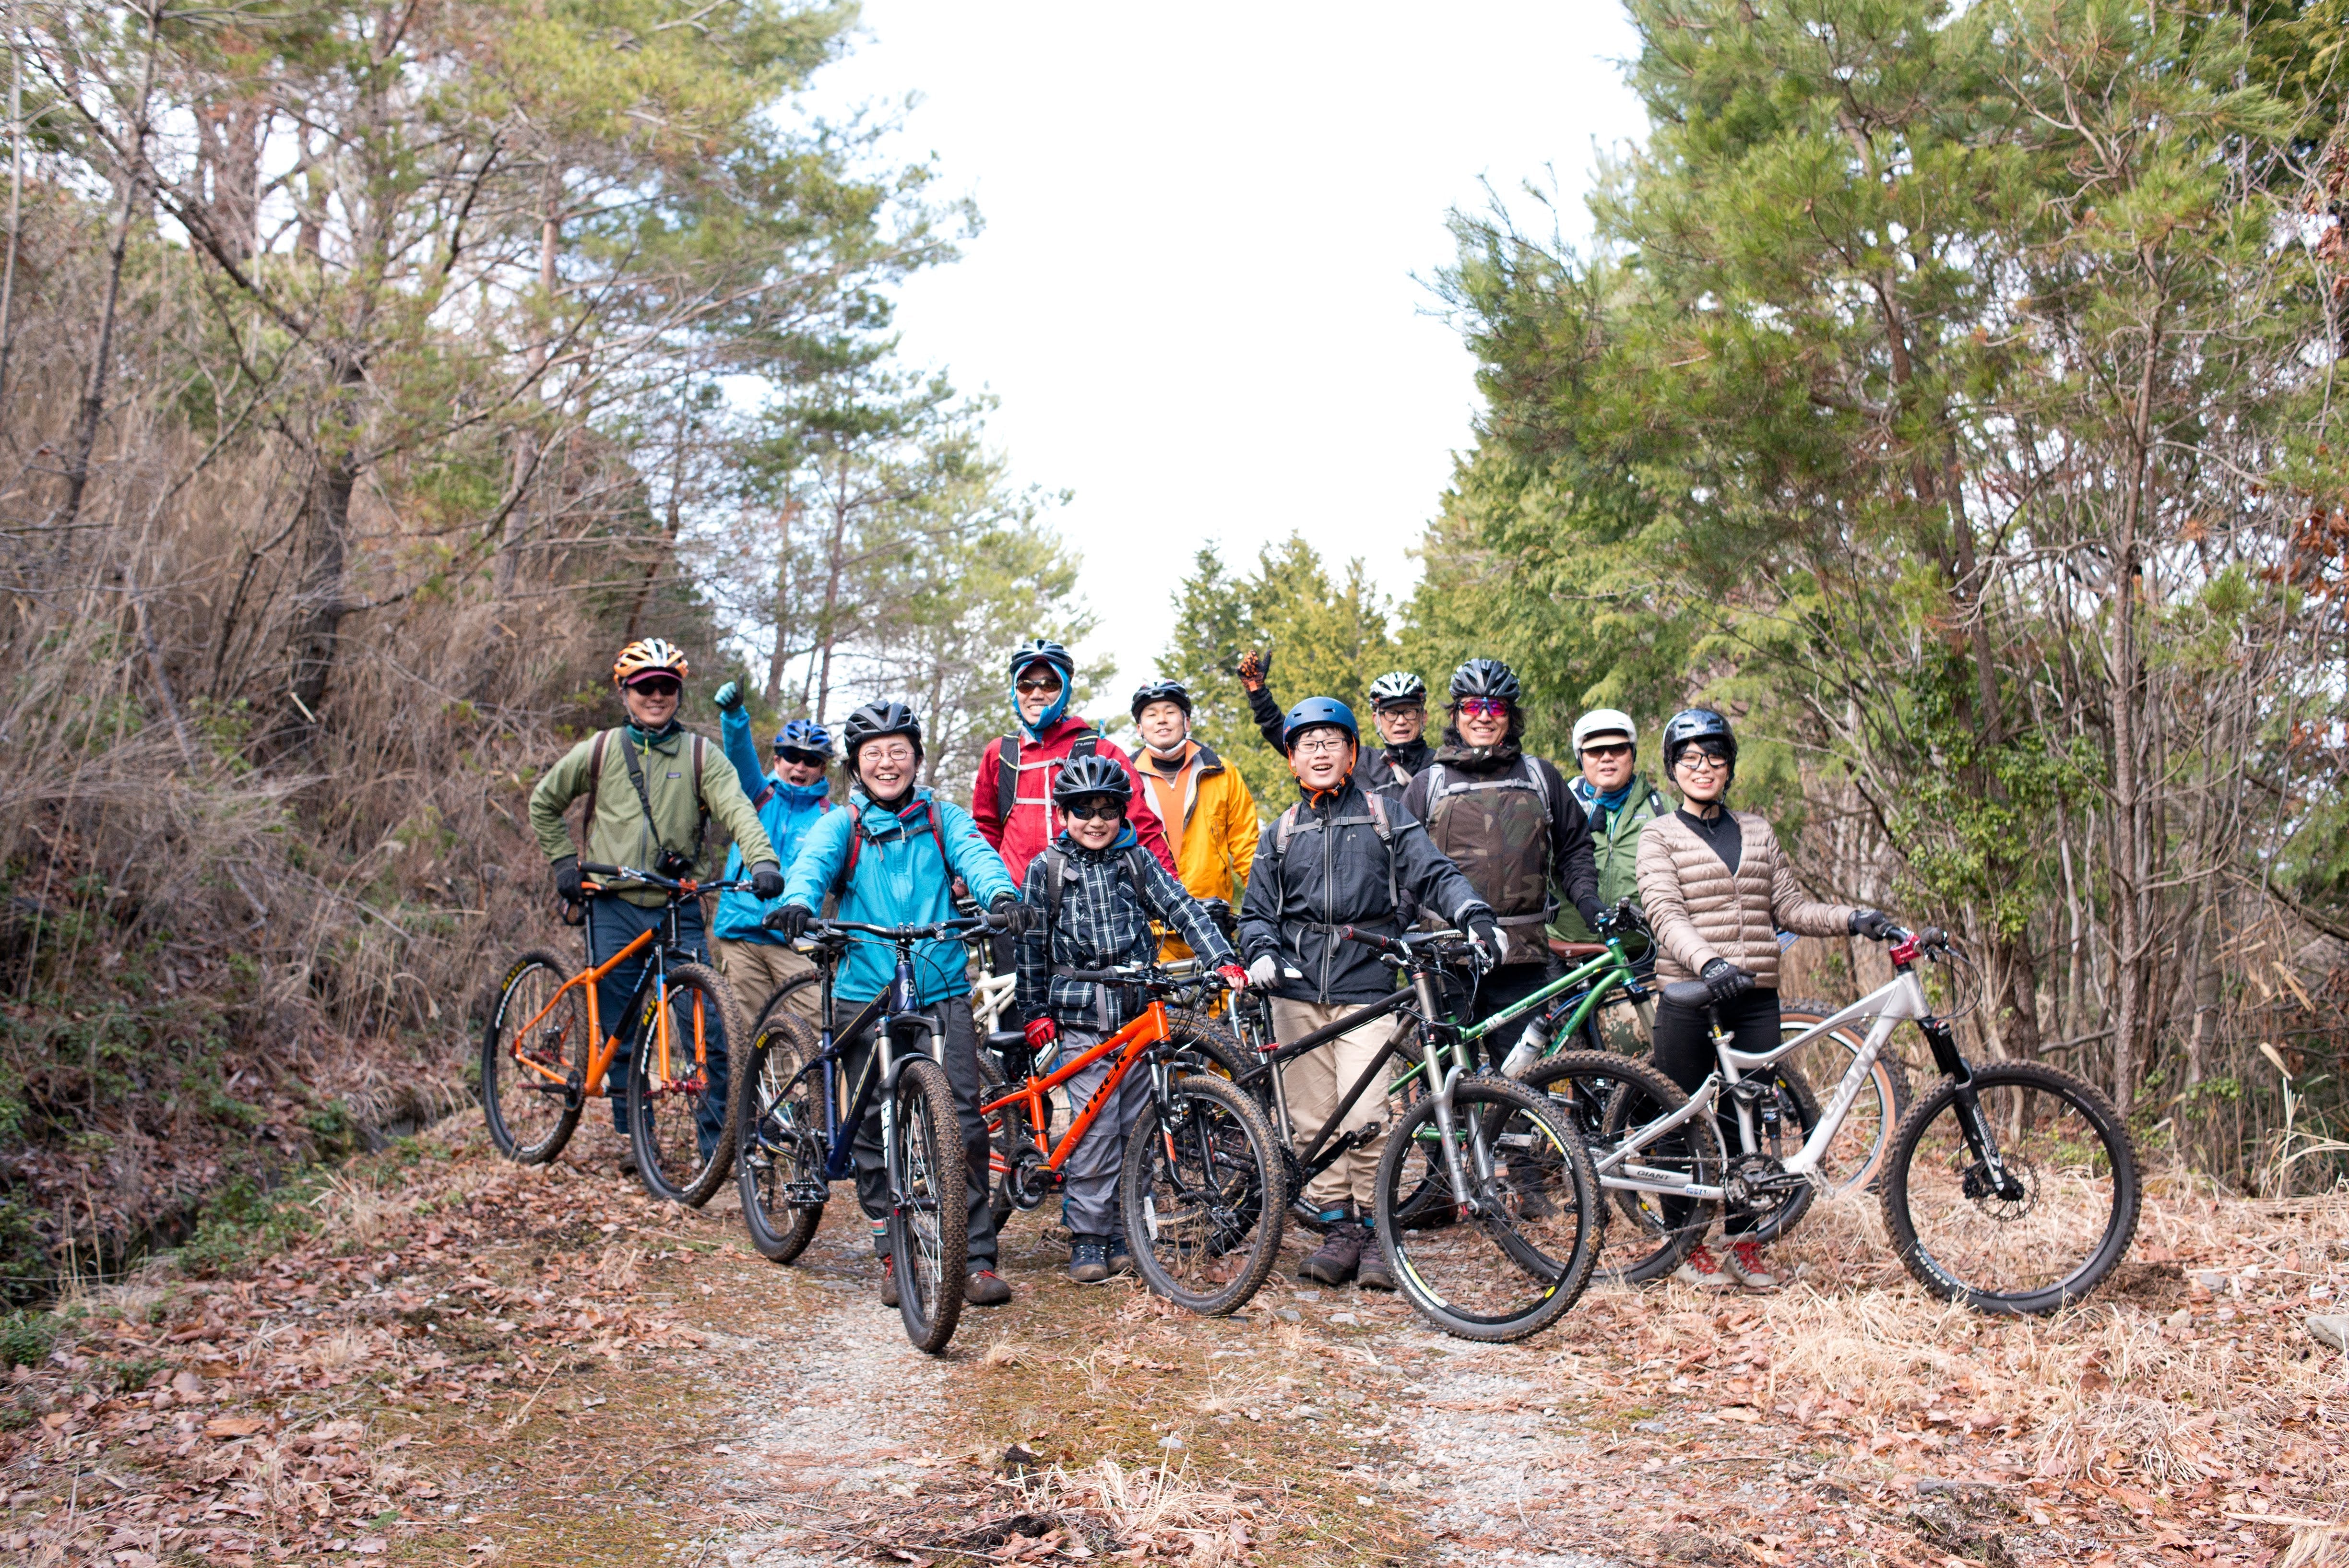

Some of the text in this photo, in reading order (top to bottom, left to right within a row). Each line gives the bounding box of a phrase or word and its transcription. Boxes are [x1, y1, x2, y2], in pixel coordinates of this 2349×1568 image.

[1084, 1056, 1127, 1115] TREK
[1823, 1033, 1880, 1120] GIANT
[1637, 1170, 1671, 1180] GIANT
[1914, 1248, 1950, 1287] KENDA
[1396, 1269, 1435, 1311] SCHWALBE
